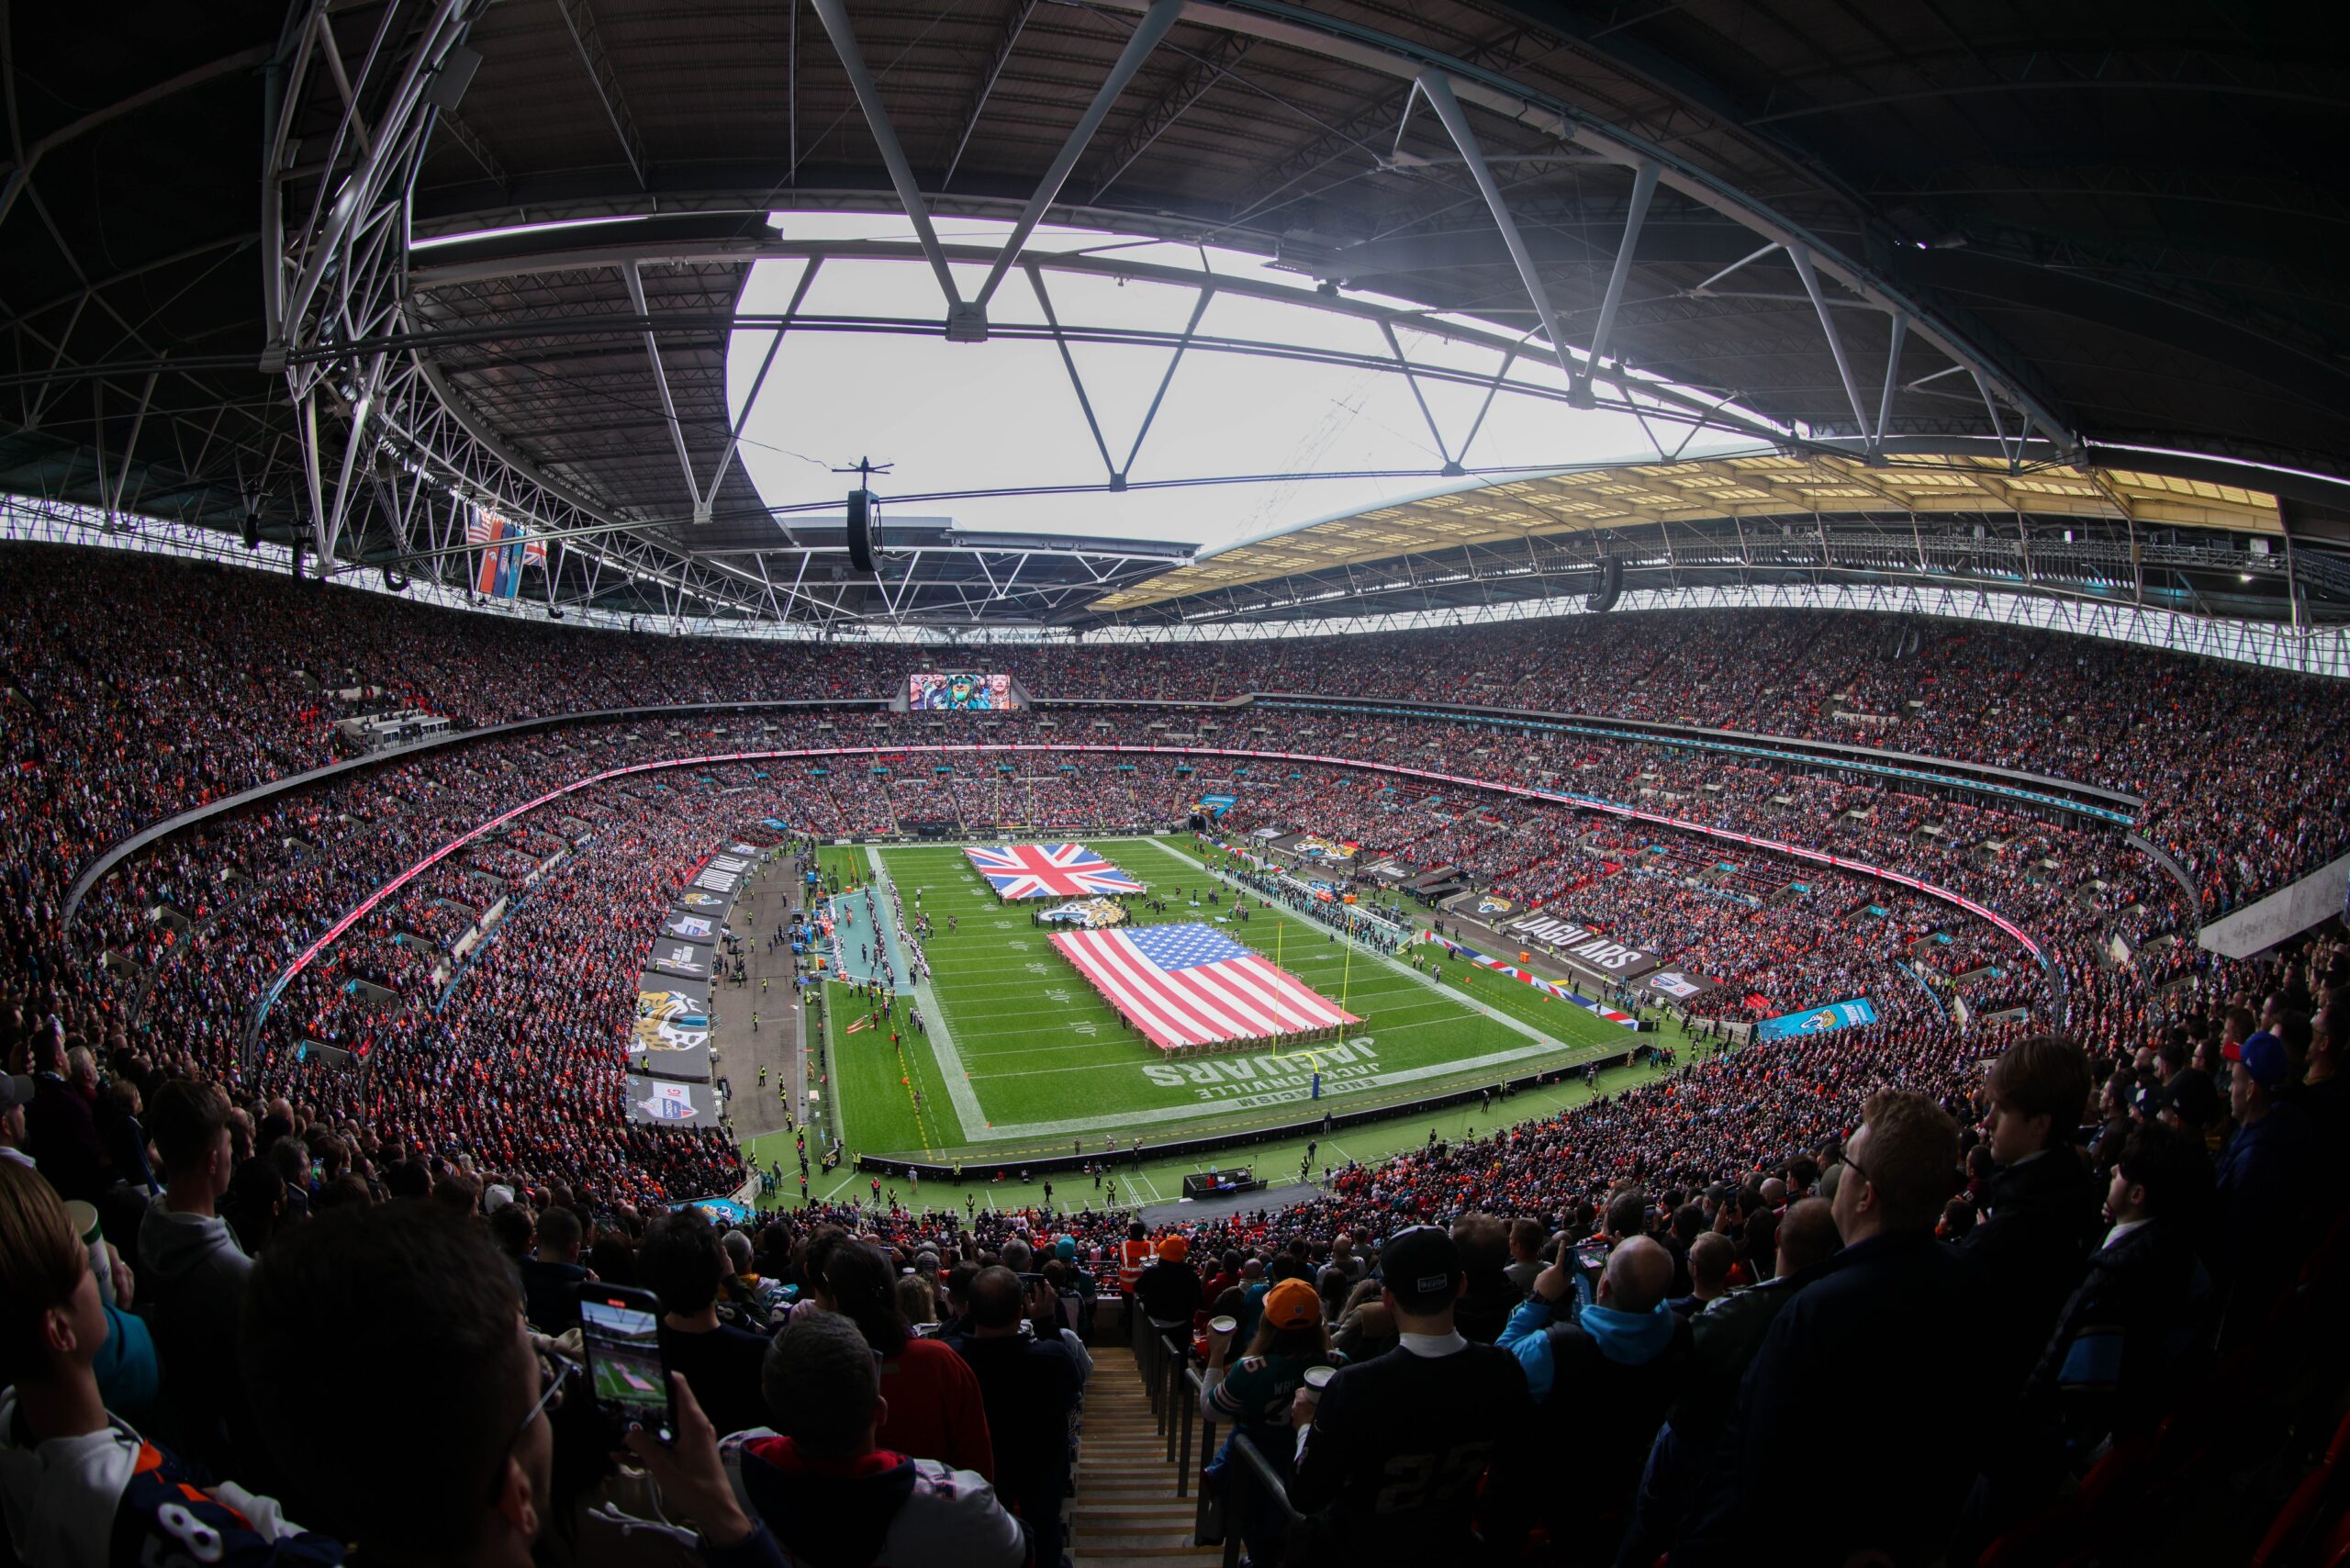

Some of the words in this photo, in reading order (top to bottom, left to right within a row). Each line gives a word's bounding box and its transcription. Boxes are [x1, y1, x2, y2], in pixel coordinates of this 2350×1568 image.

[1045, 989, 1070, 1001] 20
[1069, 1020, 1097, 1034] 10
[1142, 1036, 1379, 1087] JAGUARS
[1194, 1062, 1381, 1100] JACKSONVILLE
[1334, 1078, 1377, 1092] END
